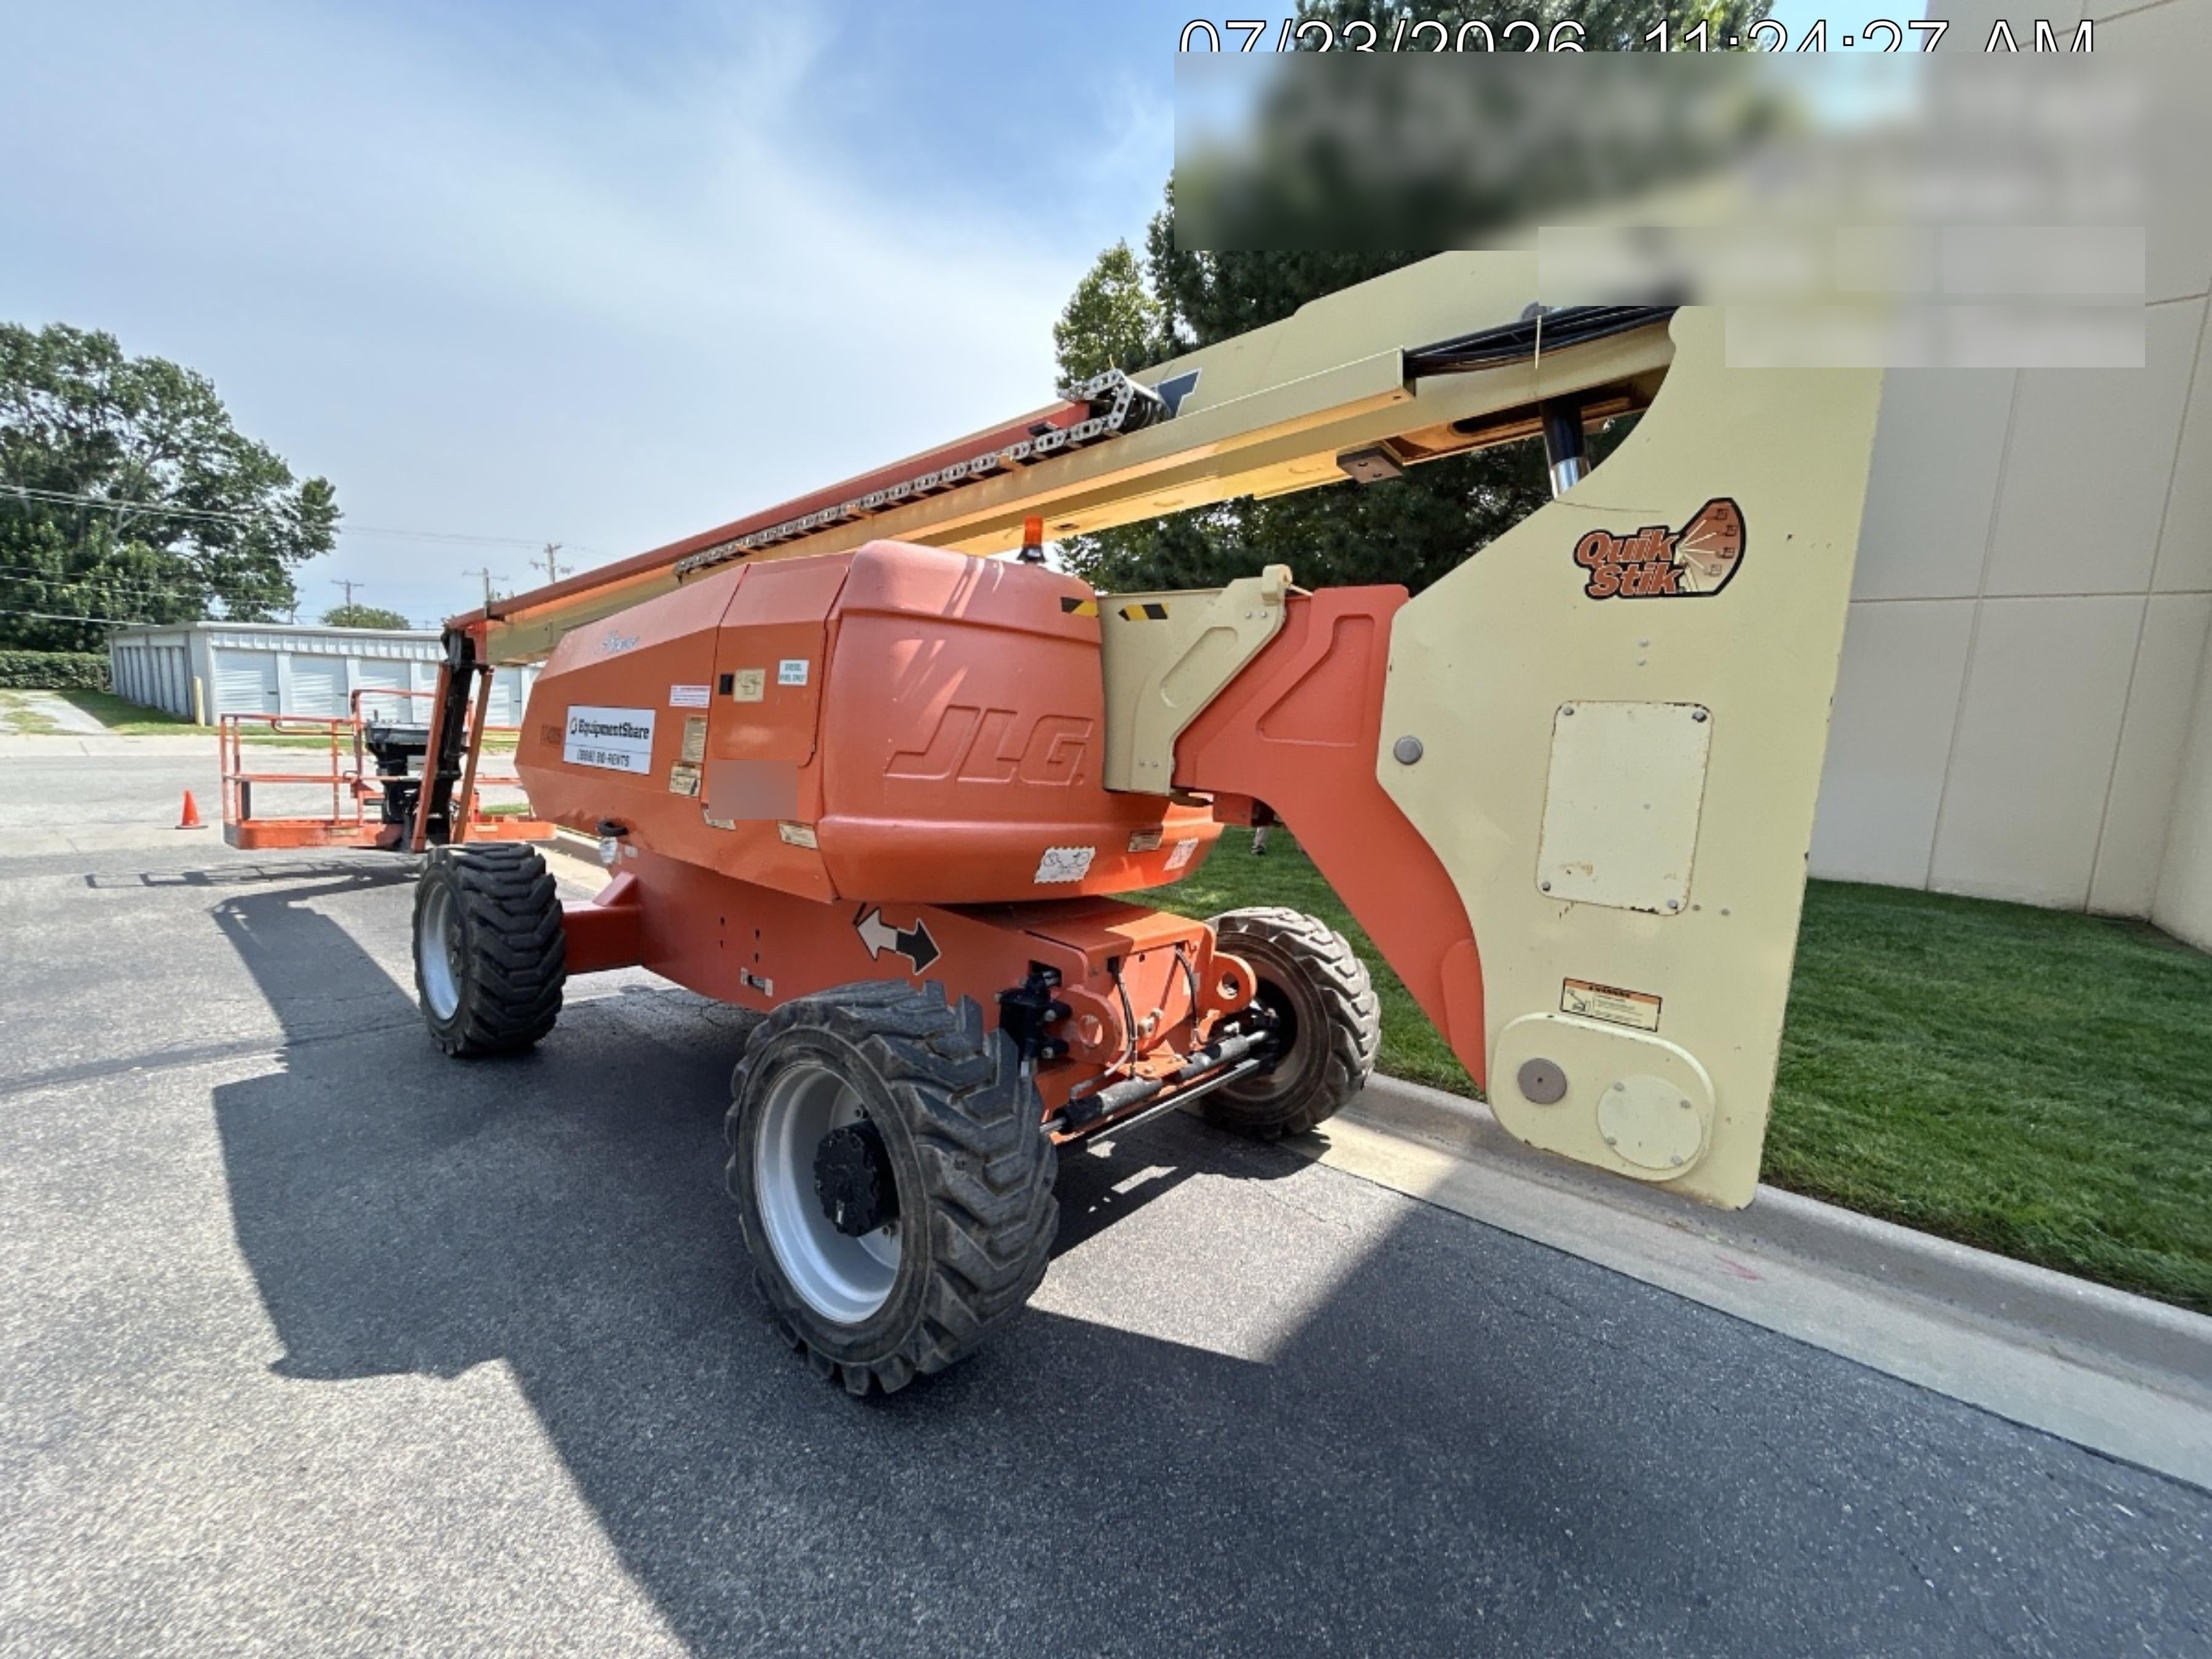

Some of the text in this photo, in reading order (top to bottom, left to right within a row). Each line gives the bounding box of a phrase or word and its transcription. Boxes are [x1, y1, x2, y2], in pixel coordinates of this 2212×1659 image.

[1574, 527, 1681, 568] Quik
[1586, 562, 1684, 597] Stik
[578, 718, 650, 740] EquipmentShare
[883, 704, 1094, 786] JLG
